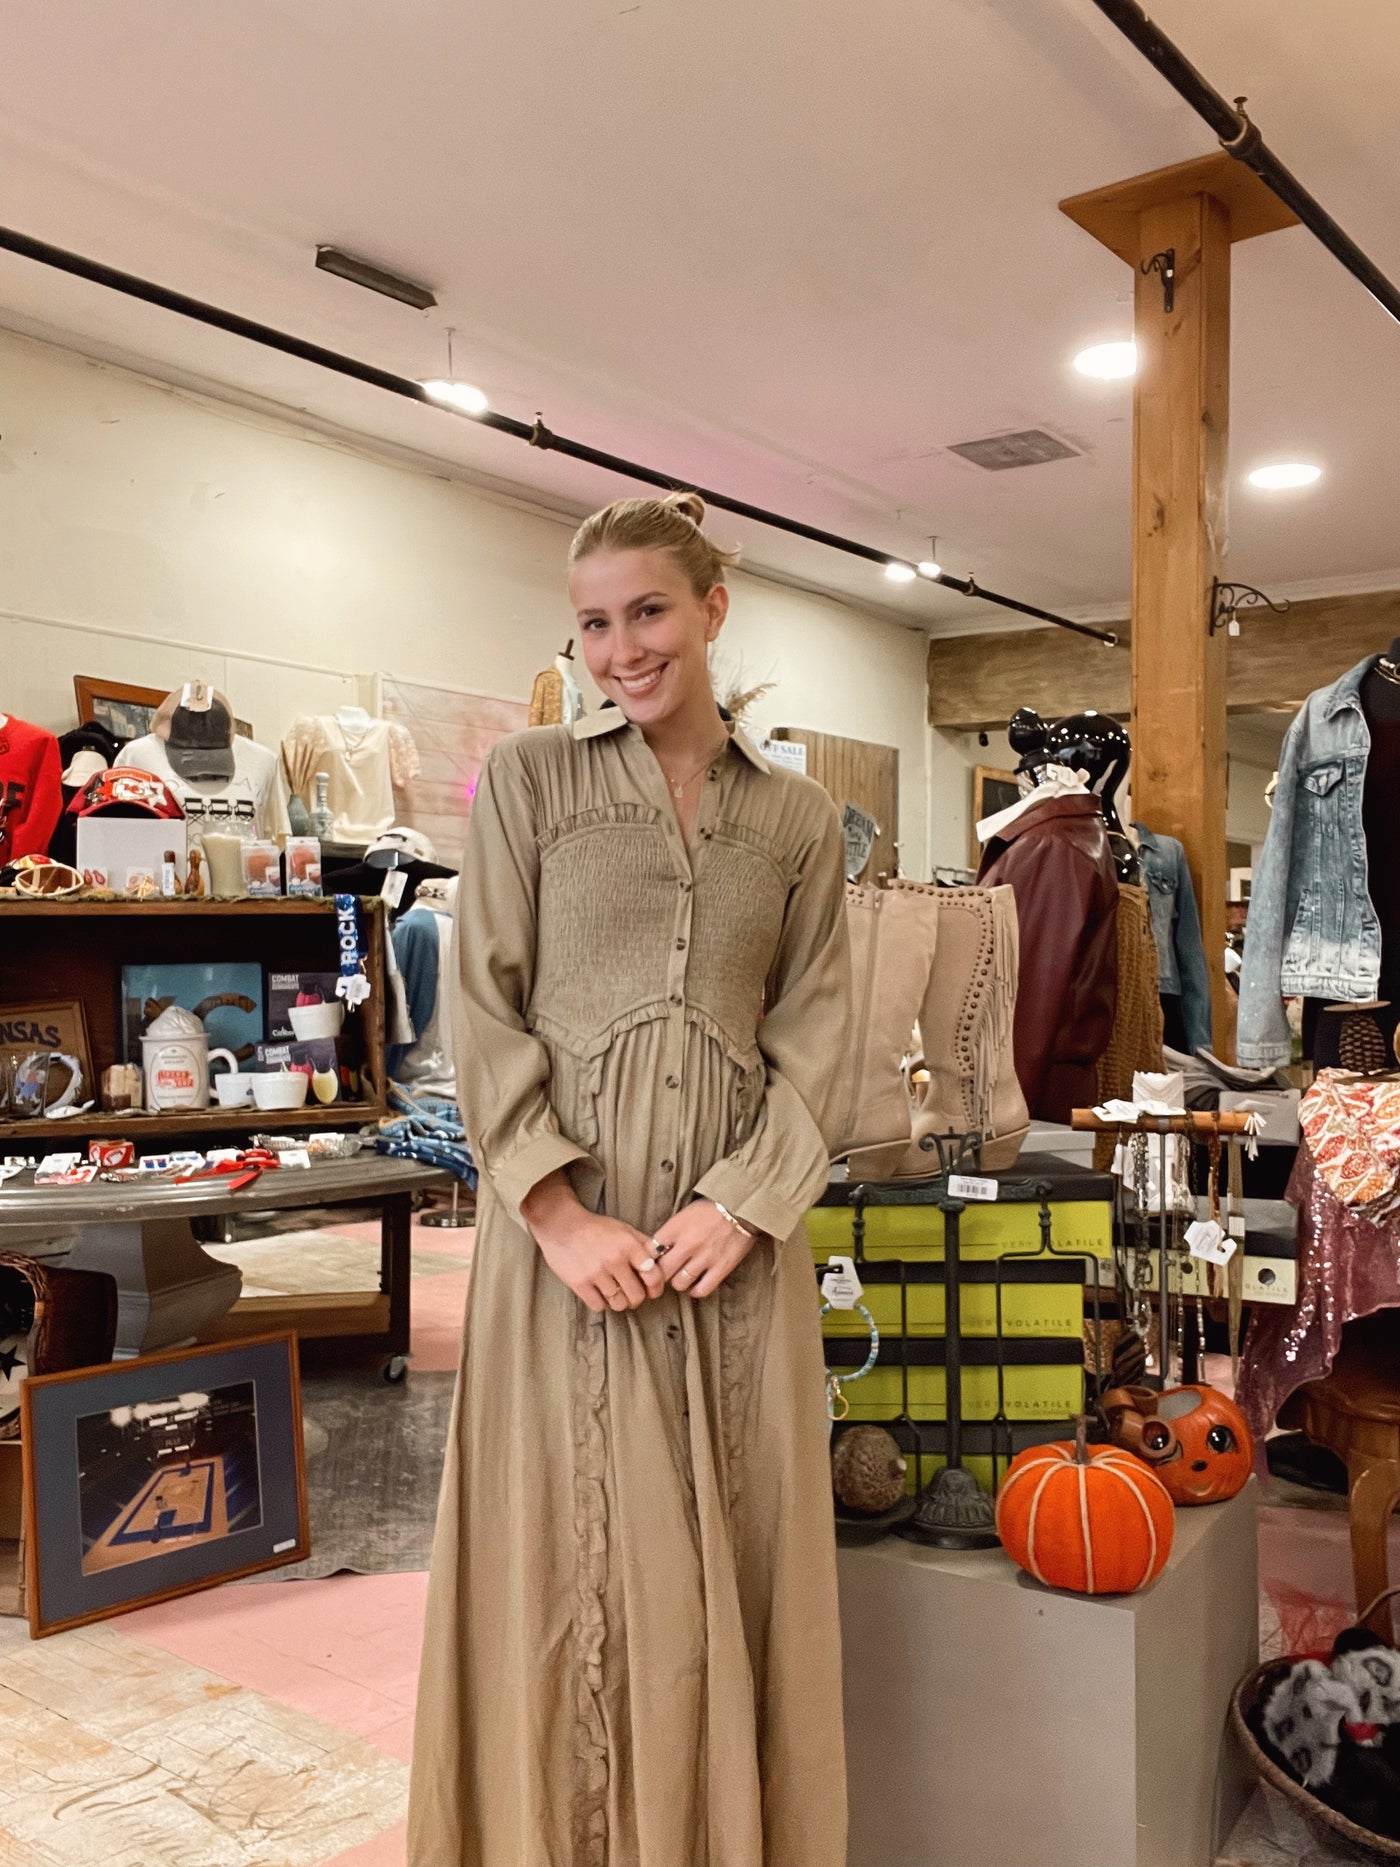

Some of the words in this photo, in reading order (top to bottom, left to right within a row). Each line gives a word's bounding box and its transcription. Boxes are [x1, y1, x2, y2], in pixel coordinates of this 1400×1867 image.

[781, 743, 804, 756] SALE
[338, 906, 358, 966] ROCK
[271, 974, 300, 982] COMBAT
[265, 1045, 290, 1057] COMBAT
[1244, 1282, 1289, 1293] OLATILE
[1006, 1319, 1072, 1327] VOLATILE
[1005, 1400, 1071, 1409] VOLATILE
